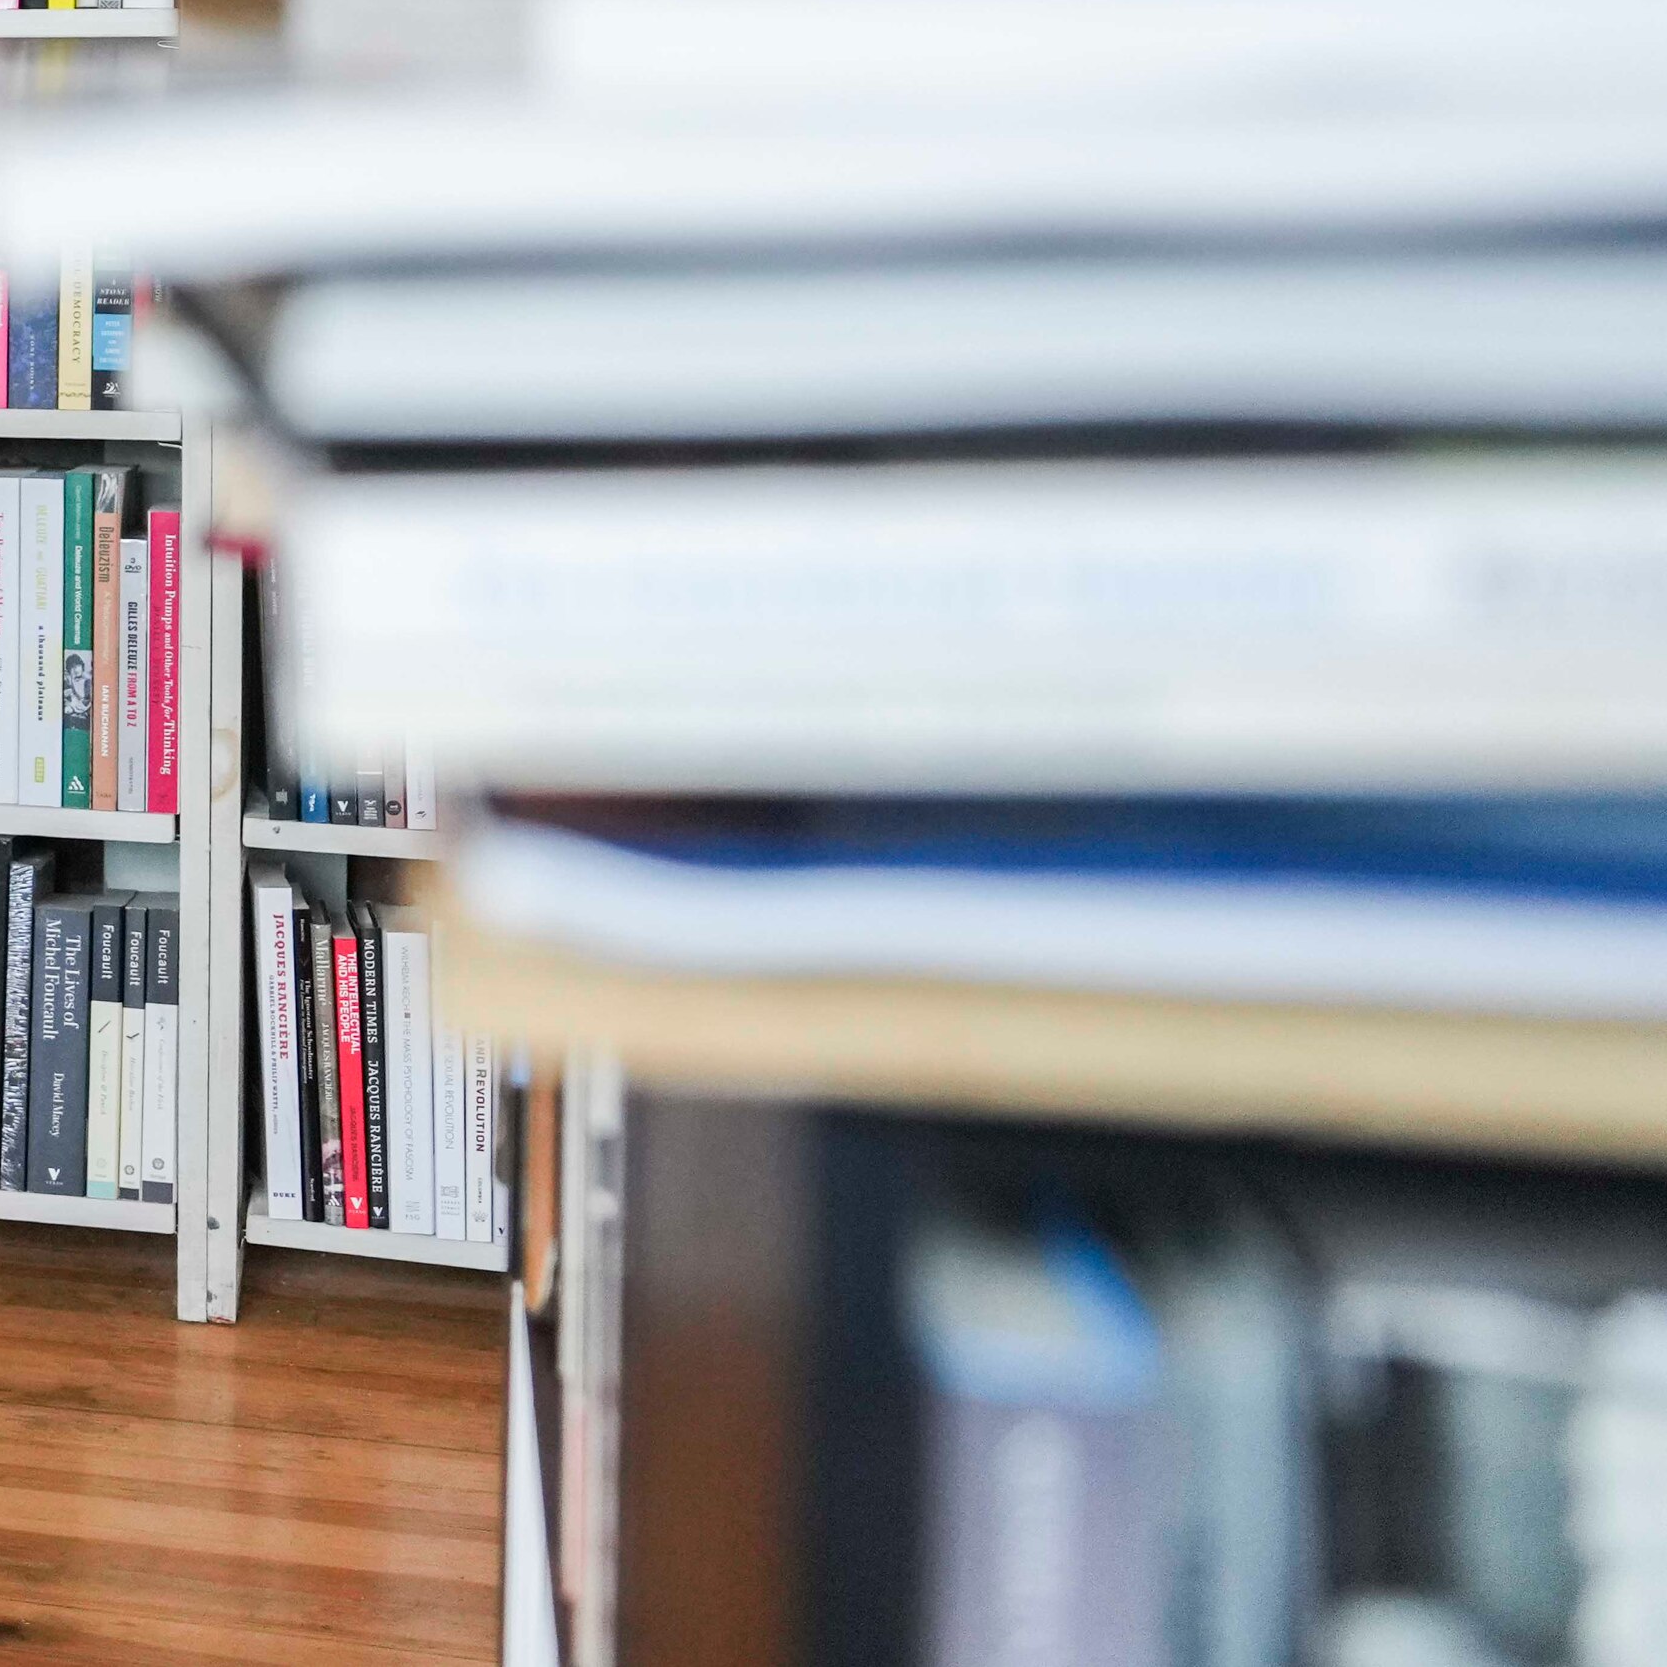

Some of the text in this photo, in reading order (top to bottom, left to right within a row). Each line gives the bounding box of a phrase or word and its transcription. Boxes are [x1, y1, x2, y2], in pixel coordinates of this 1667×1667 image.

[102, 924, 115, 979] Foucault
[273, 913, 290, 1060] JACQUES RANCIÈRE
